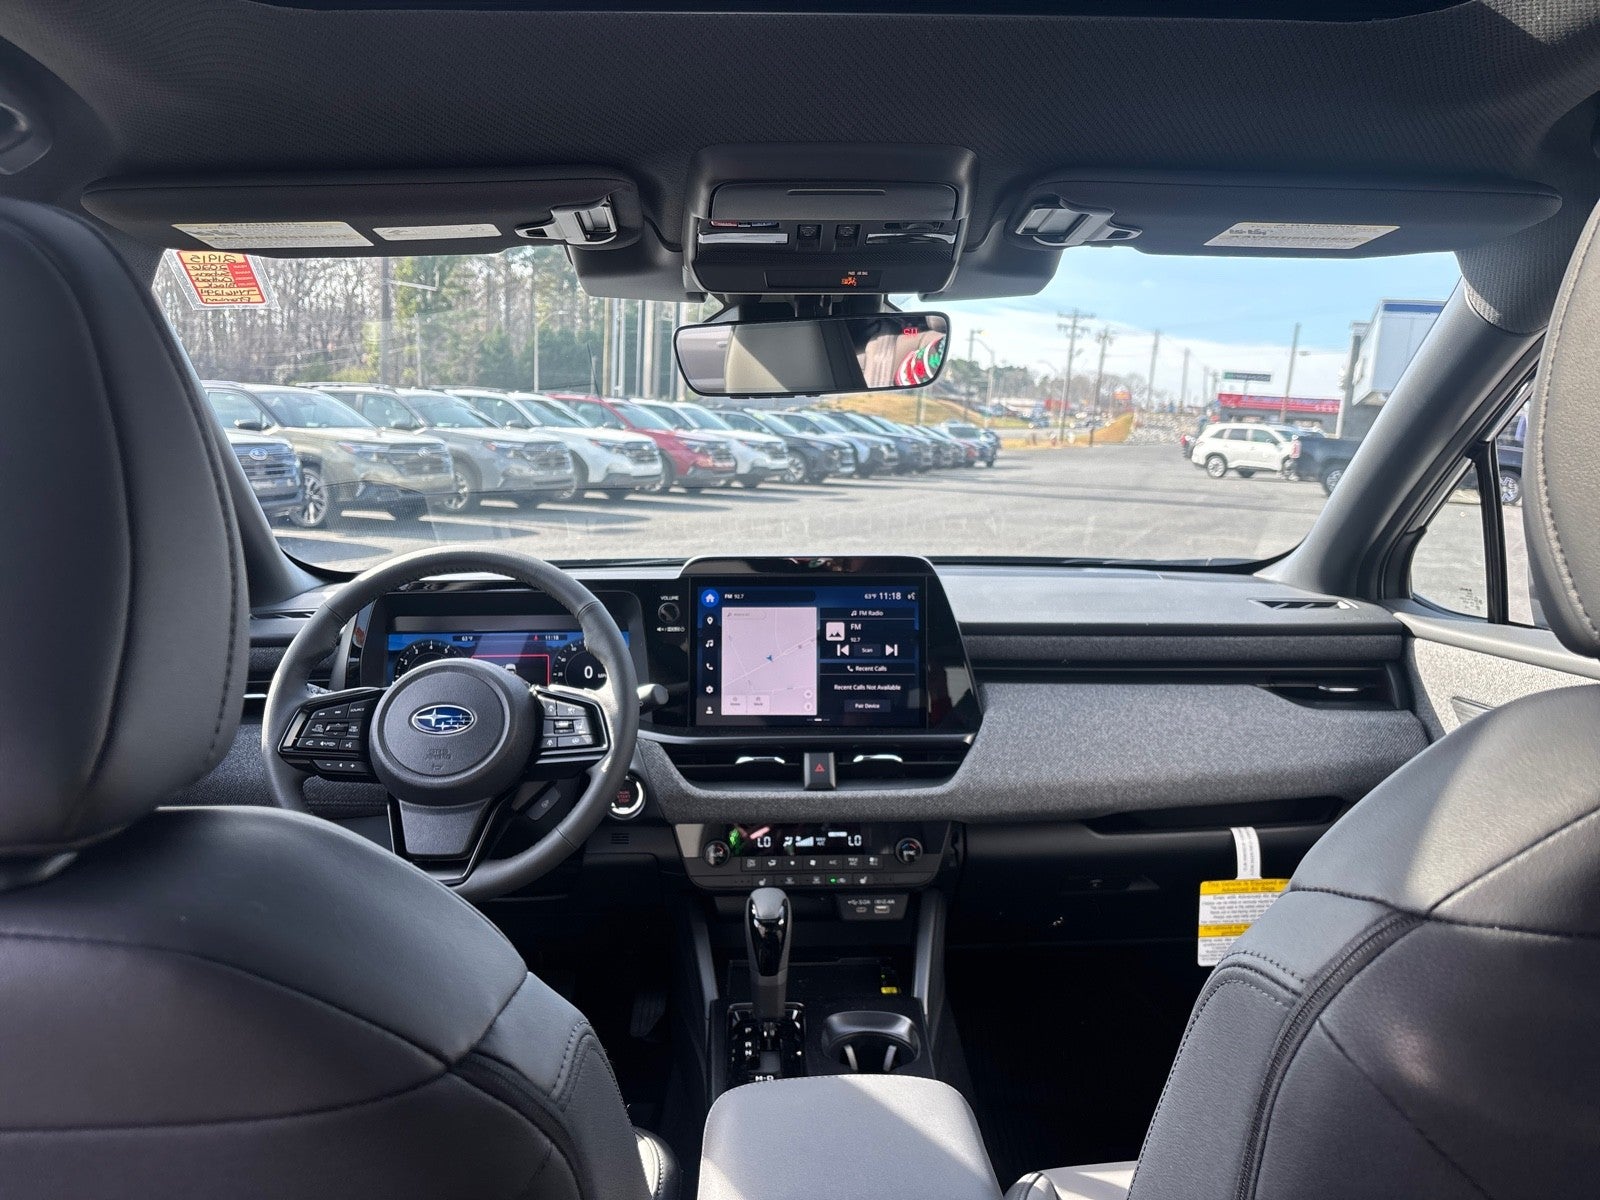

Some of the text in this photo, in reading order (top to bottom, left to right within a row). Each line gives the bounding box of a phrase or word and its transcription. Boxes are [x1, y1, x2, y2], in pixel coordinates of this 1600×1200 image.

[879, 592, 901, 600] 11:18
[584, 665, 593, 679] 0
[757, 836, 771, 848] LO
[848, 835, 862, 846] LO
